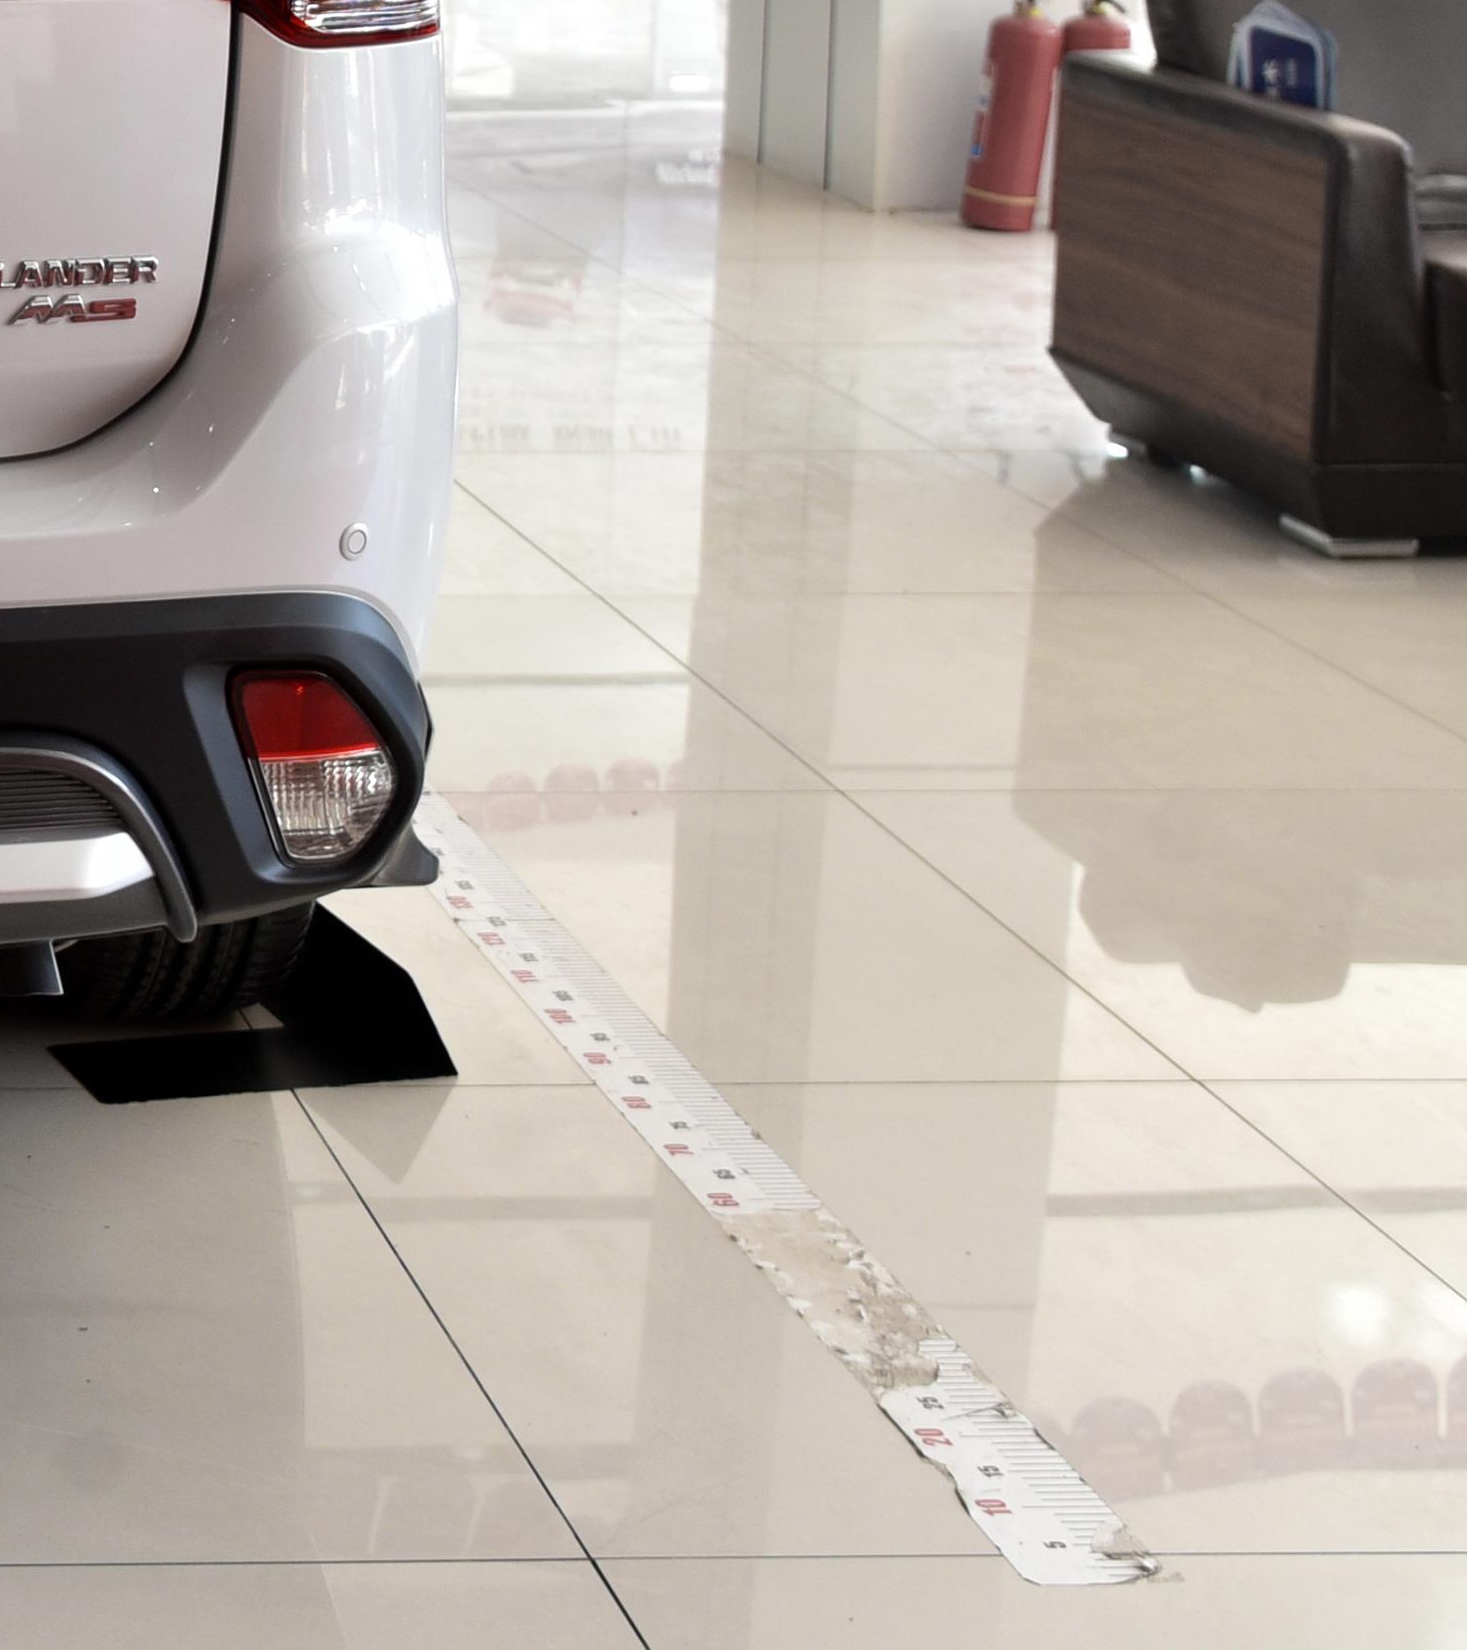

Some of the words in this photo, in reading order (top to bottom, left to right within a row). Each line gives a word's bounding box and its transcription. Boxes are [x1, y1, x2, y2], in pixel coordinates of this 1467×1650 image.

[663, 1143, 694, 1157] 70
[707, 1192, 740, 1207] 60
[916, 1396, 946, 1411] 25
[913, 1427, 954, 1447] 20
[978, 1465, 1003, 1479] 15
[975, 1499, 1013, 1517] 10
[1043, 1540, 1067, 1549] 5
